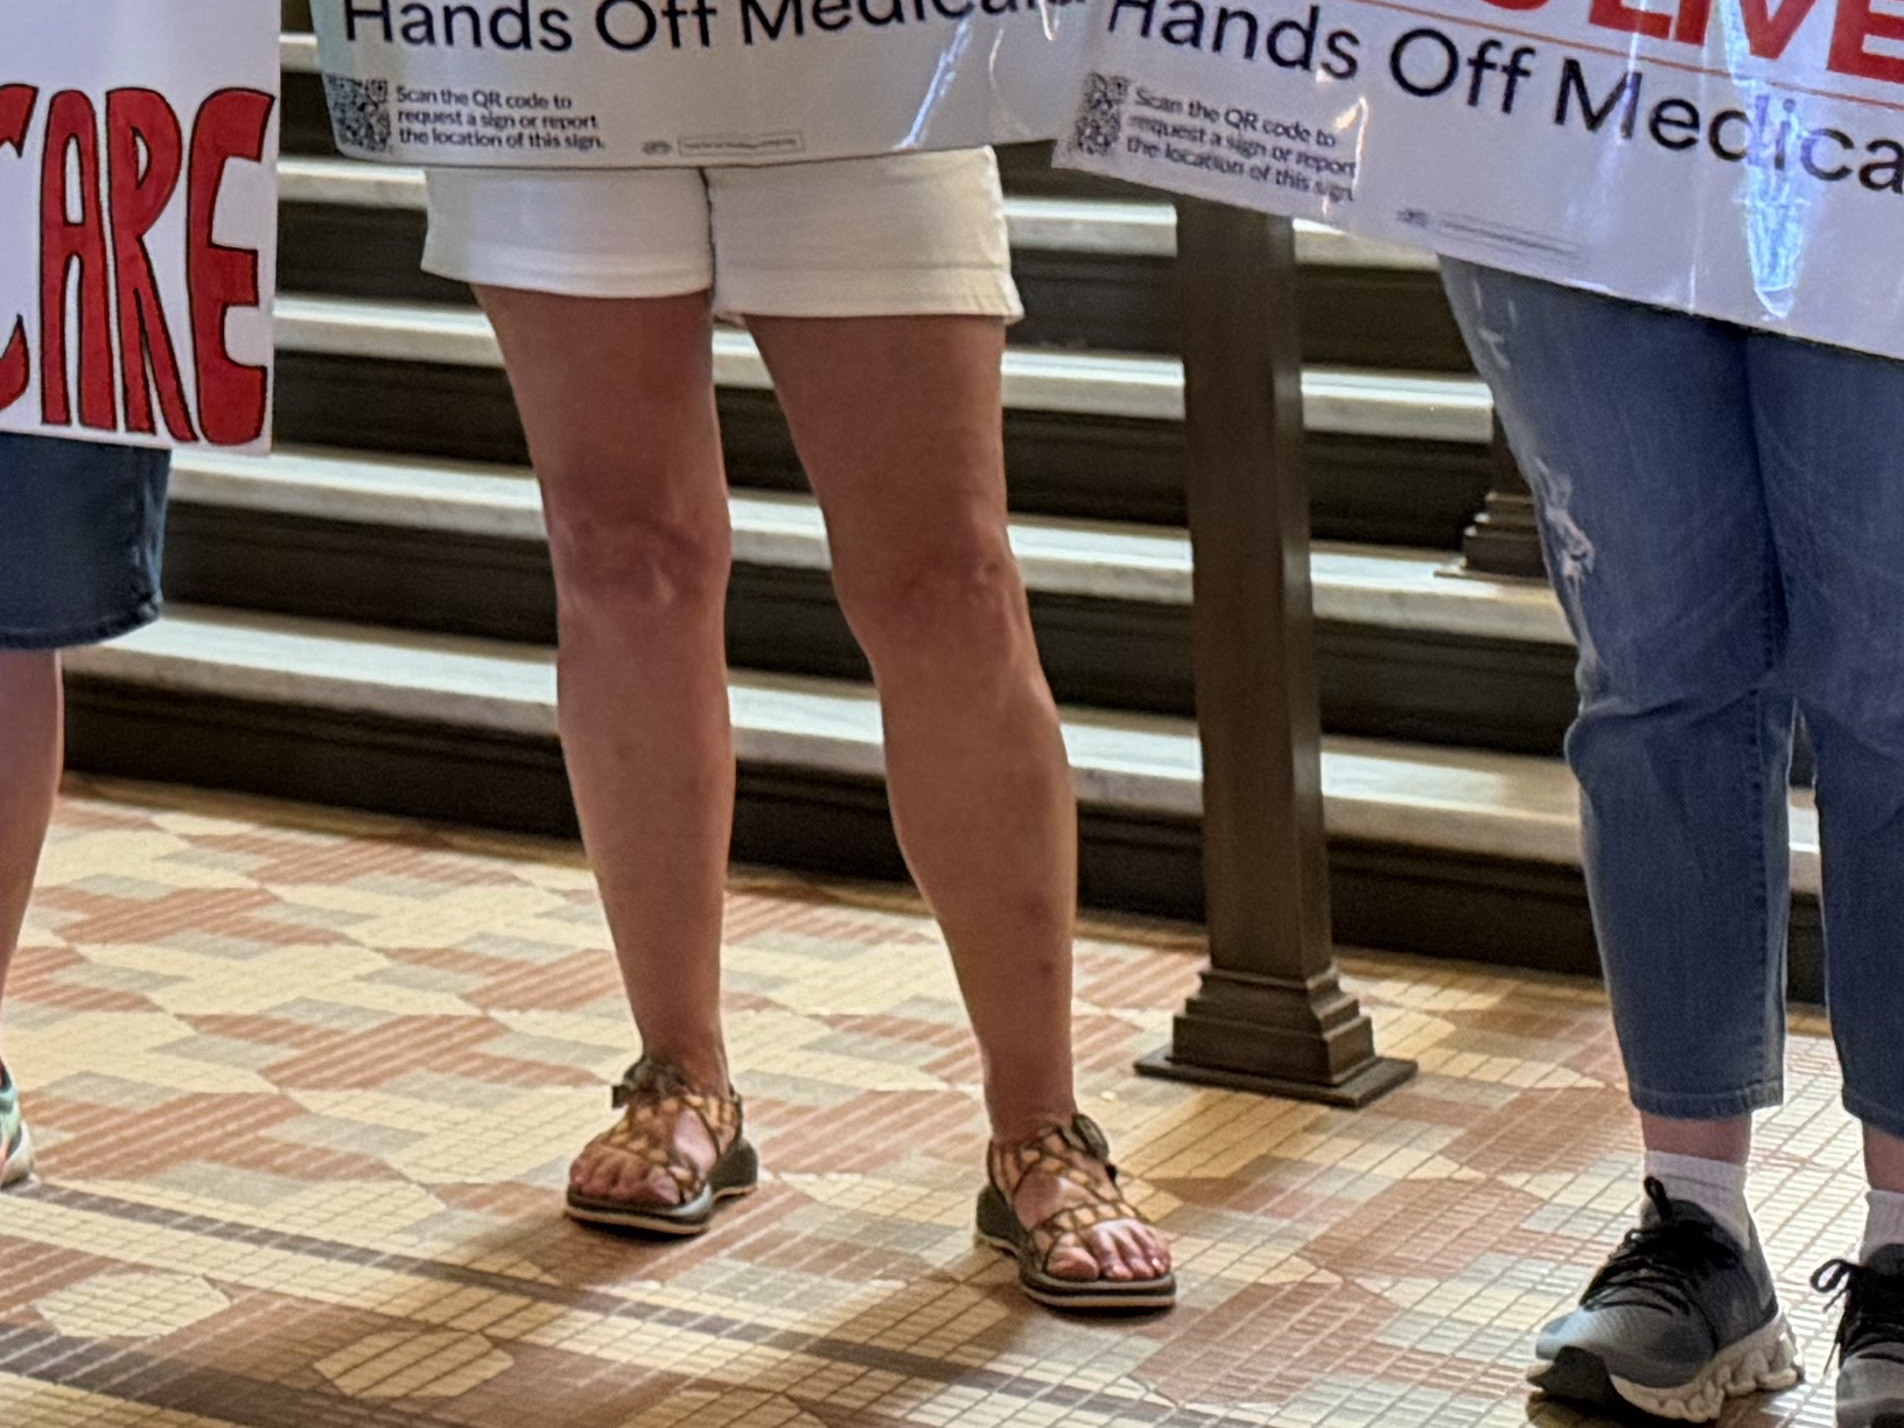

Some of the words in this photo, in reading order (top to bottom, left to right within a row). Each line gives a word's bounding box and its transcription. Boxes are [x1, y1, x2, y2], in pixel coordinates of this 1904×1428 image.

[1390, 28, 1536, 114] Off
[396, 86, 437, 103] Scan
[440, 89, 468, 106] the
[472, 90, 502, 111] QR
[506, 92, 549, 110] code
[553, 93, 572, 110] to
[398, 110, 463, 127] request
[467, 113, 477, 126] a
[480, 111, 515, 132] sign
[519, 116, 537, 129] or
[542, 114, 598, 131] report
[1136, 88, 1182, 113] Scan
[1189, 99, 1220, 123] the
[1224, 109, 1258, 131] QR
[1262, 119, 1311, 142] code
[399, 128, 429, 145] the
[431, 128, 502, 148] location
[506, 131, 523, 148] of
[528, 132, 560, 149] this
